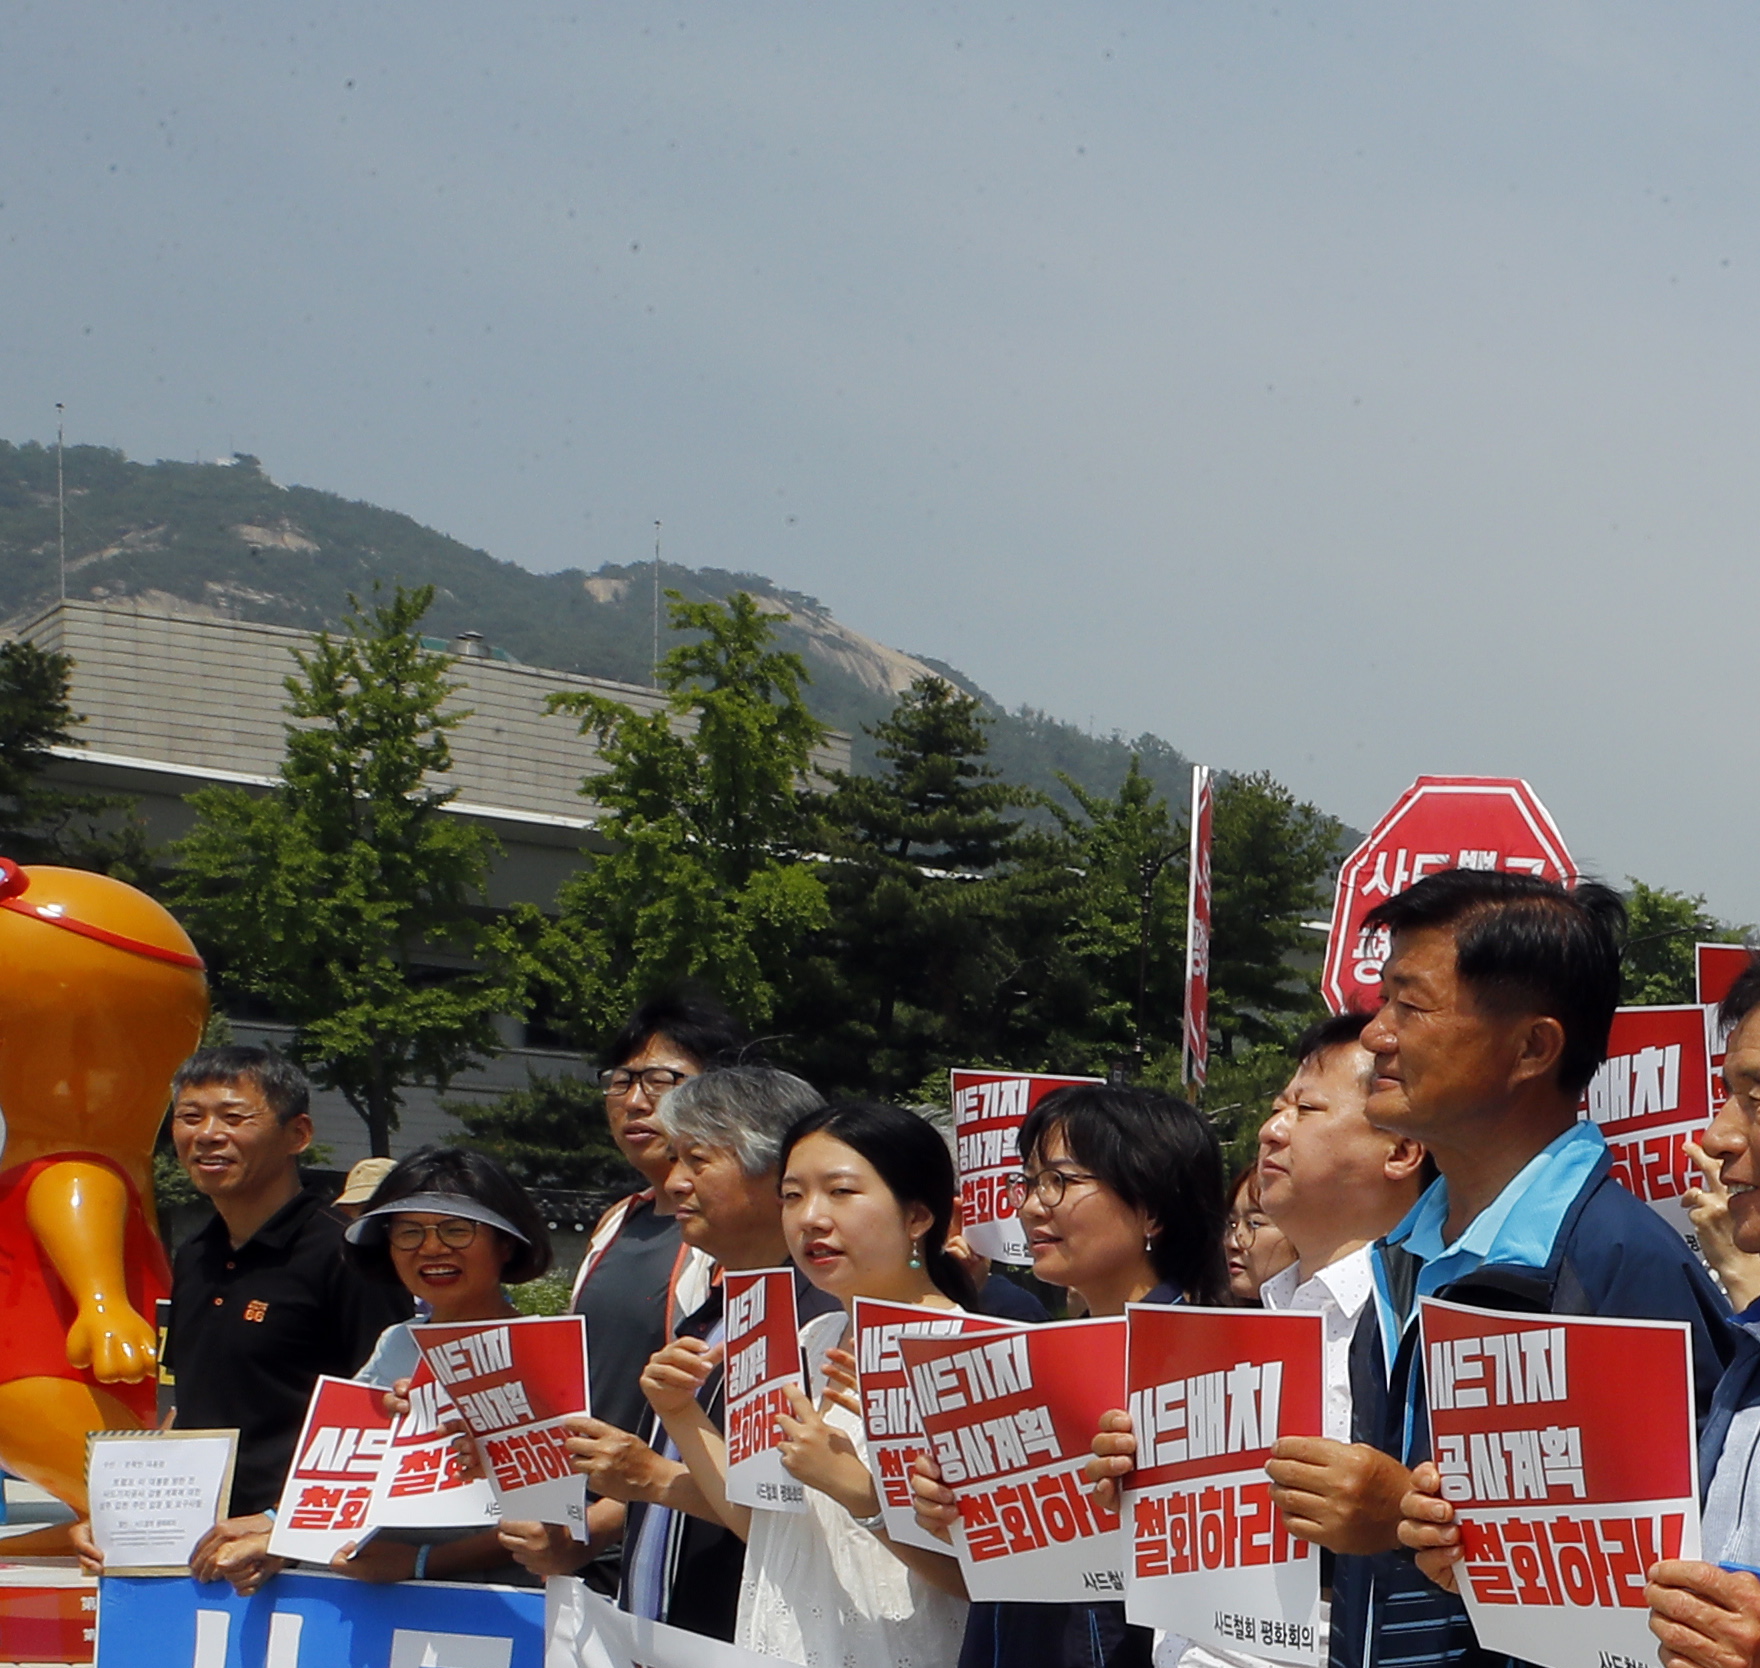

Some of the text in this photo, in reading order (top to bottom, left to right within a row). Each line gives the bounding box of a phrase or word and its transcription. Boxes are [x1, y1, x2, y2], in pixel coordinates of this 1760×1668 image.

[913, 1335, 1032, 1417] 사드기지
[1430, 1327, 1567, 1410] 사드기지
[933, 1406, 1062, 1483] 공사계획
[1131, 1361, 1283, 1470] 사드배치
[1437, 1425, 1587, 1500] 공사계획
[1083, 1571, 1124, 1592] 사드철
[1214, 1612, 1314, 1652] 사드철회 평화회의
